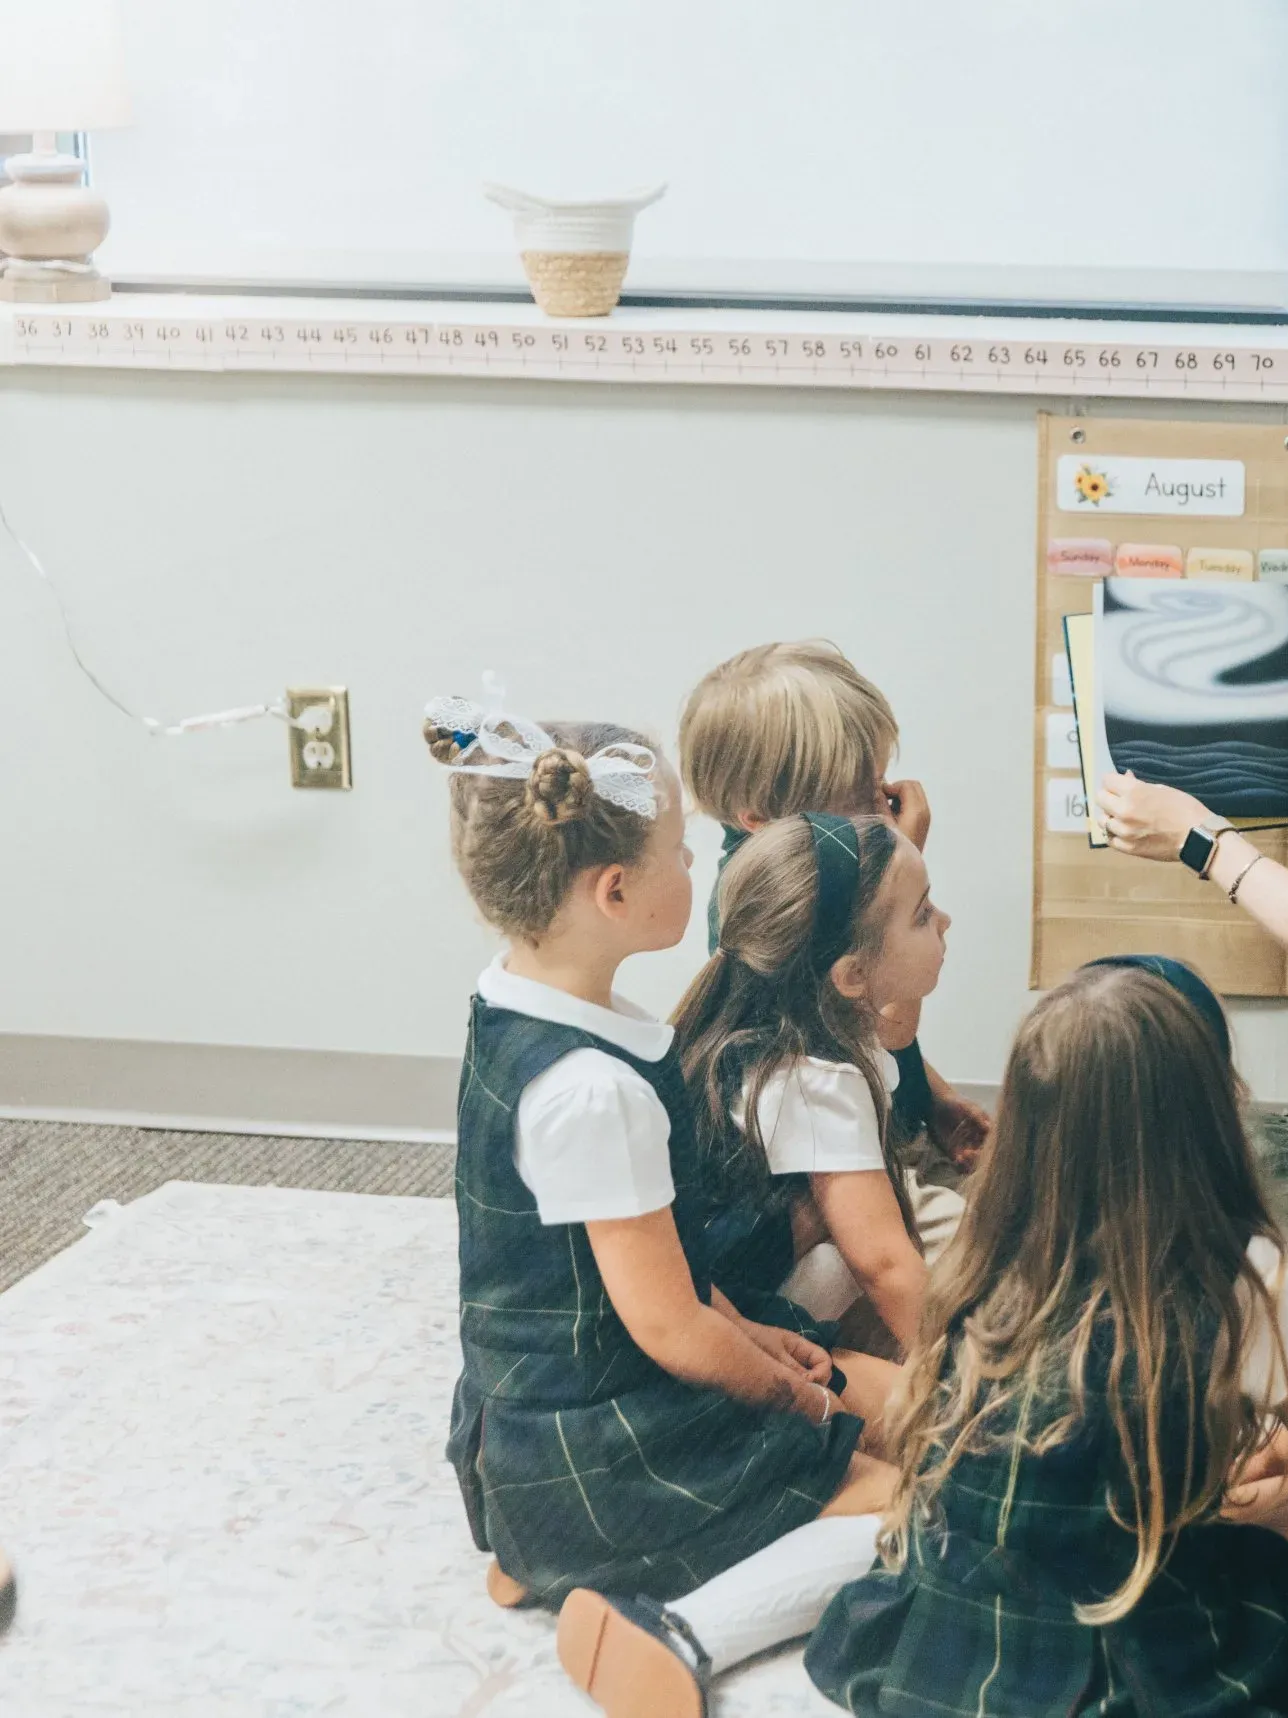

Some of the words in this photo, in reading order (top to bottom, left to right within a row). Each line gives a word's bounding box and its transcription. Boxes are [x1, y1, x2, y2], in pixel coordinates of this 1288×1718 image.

[15, 319, 38, 336] 36
[51, 321, 73, 337] 37
[87, 323, 110, 339] 38
[122, 323, 144, 341] 39
[156, 326, 181, 342] 40
[194, 327, 214, 343] 41
[225, 325, 249, 342] 42
[260, 326, 285, 342] 43
[296, 328, 322, 343] 44
[332, 327, 358, 344] 45
[368, 327, 394, 345] 46
[405, 328, 430, 345] 47
[438, 329, 464, 346] 48
[474, 330, 499, 347] 49
[511, 332, 536, 349] 50
[551, 334, 569, 351] 51
[584, 334, 608, 352] 52
[621, 336, 645, 355] 53
[653, 337, 678, 354] 54
[689, 337, 714, 355] 55
[728, 338, 752, 356] 56
[765, 339, 789, 357] 57
[801, 340, 826, 358] 58
[839, 341, 863, 359] 59
[874, 342, 899, 359] 60
[914, 343, 932, 361] 61
[949, 344, 974, 362] 62
[987, 345, 1011, 365] 63
[1023, 347, 1049, 365] 64
[1063, 348, 1086, 367] 65
[1098, 349, 1121, 368] 66
[1135, 351, 1159, 368] 67
[1174, 351, 1199, 370] 68
[1212, 353, 1236, 371] 69
[1250, 354, 1274, 371] 70
[1145, 473, 1226, 505] August
[1060, 550, 1100, 564] Sunday
[1129, 557, 1170, 571] Monday
[1200, 559, 1242, 575] Tuesday
[1065, 793, 1086, 818] 16
